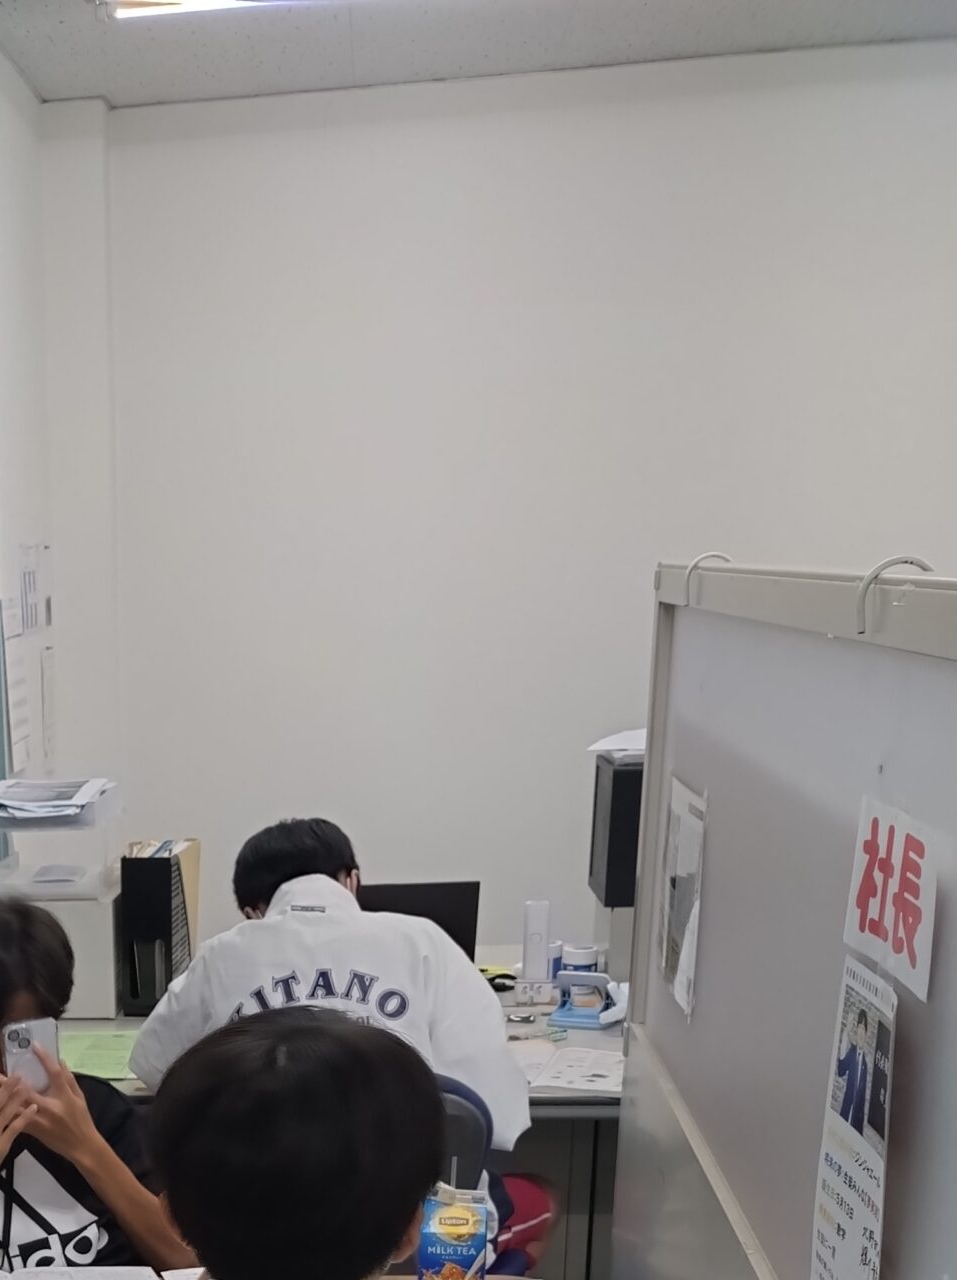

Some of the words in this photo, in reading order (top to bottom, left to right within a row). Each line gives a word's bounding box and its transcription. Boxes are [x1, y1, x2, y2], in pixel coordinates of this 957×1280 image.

[855, 816, 926, 970] 社長
[427, 1246, 454, 1256] MILK
[456, 1247, 477, 1256] TEA
